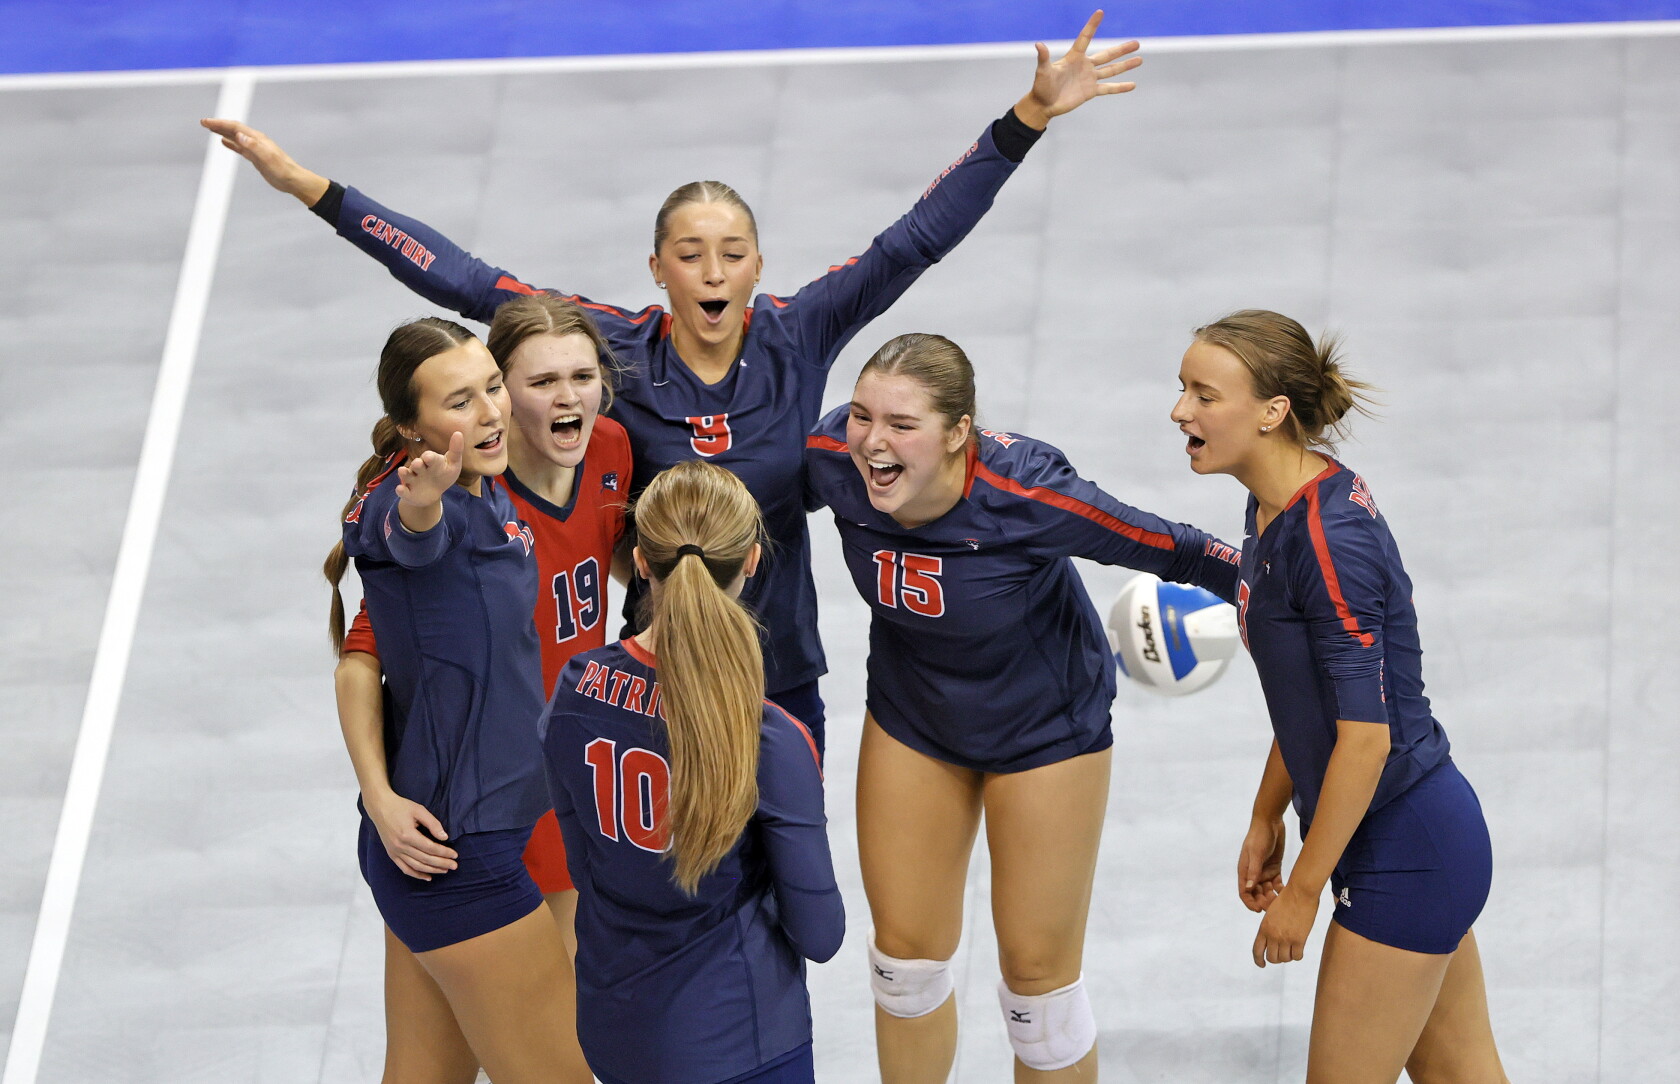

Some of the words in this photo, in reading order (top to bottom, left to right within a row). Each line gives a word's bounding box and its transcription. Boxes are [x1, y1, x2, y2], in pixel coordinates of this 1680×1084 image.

[360, 214, 437, 272] CENTURY
[685, 412, 733, 458] 9
[552, 556, 601, 645] 19
[872, 549, 945, 618] 15
[585, 737, 674, 854] 10
